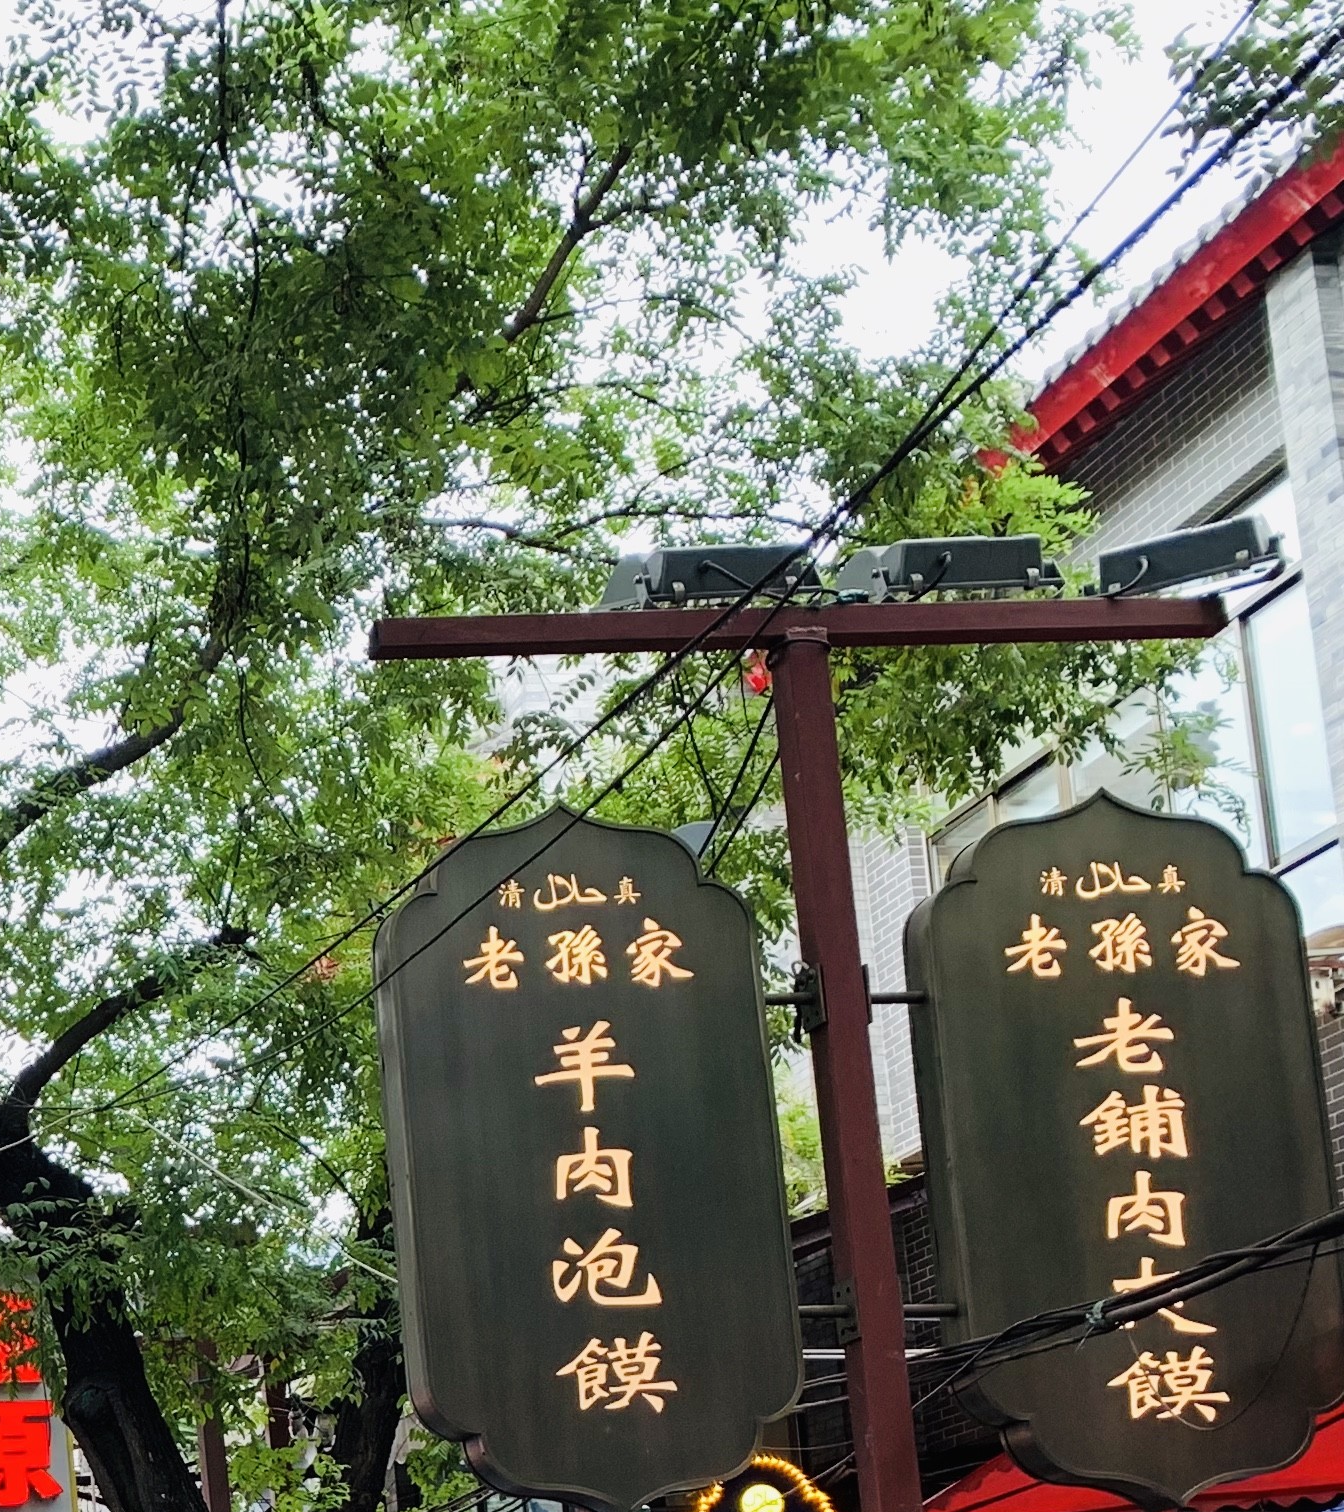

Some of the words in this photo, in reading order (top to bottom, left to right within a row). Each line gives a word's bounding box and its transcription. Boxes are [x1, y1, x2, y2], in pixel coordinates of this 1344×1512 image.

[497, 878, 526, 909] 清
[612, 875, 642, 906] 真
[1039, 866, 1068, 898] 清
[1158, 863, 1186, 894] 真
[463, 916, 695, 989] 老孫家
[1005, 906, 1242, 979] 老孫家
